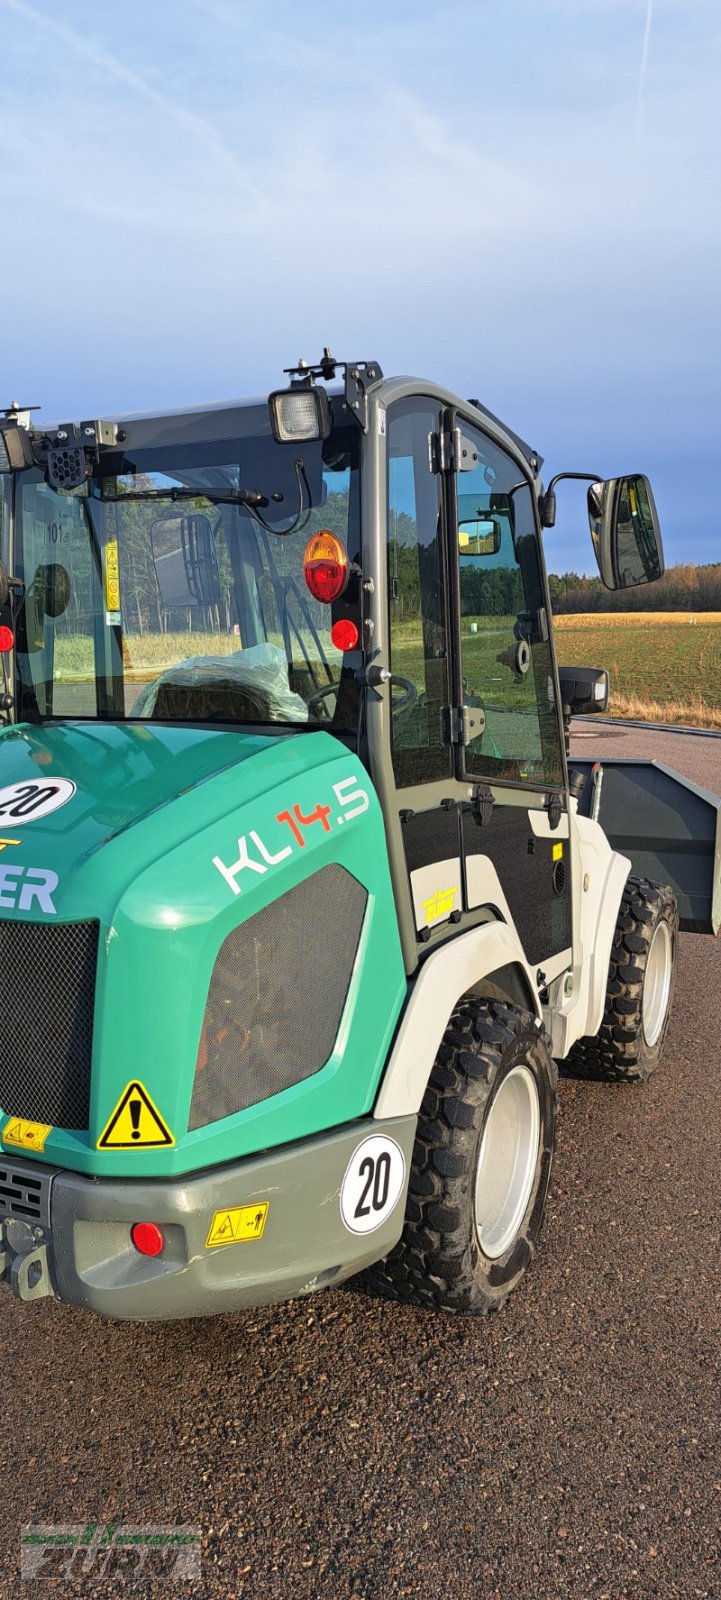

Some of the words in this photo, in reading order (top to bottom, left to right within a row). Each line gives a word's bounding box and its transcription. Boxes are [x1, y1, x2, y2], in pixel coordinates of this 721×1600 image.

[47, 522, 63, 544] 101
[0, 785, 60, 817] 20
[212, 776, 370, 895] KL14.5
[354, 1151, 391, 1219] 20
